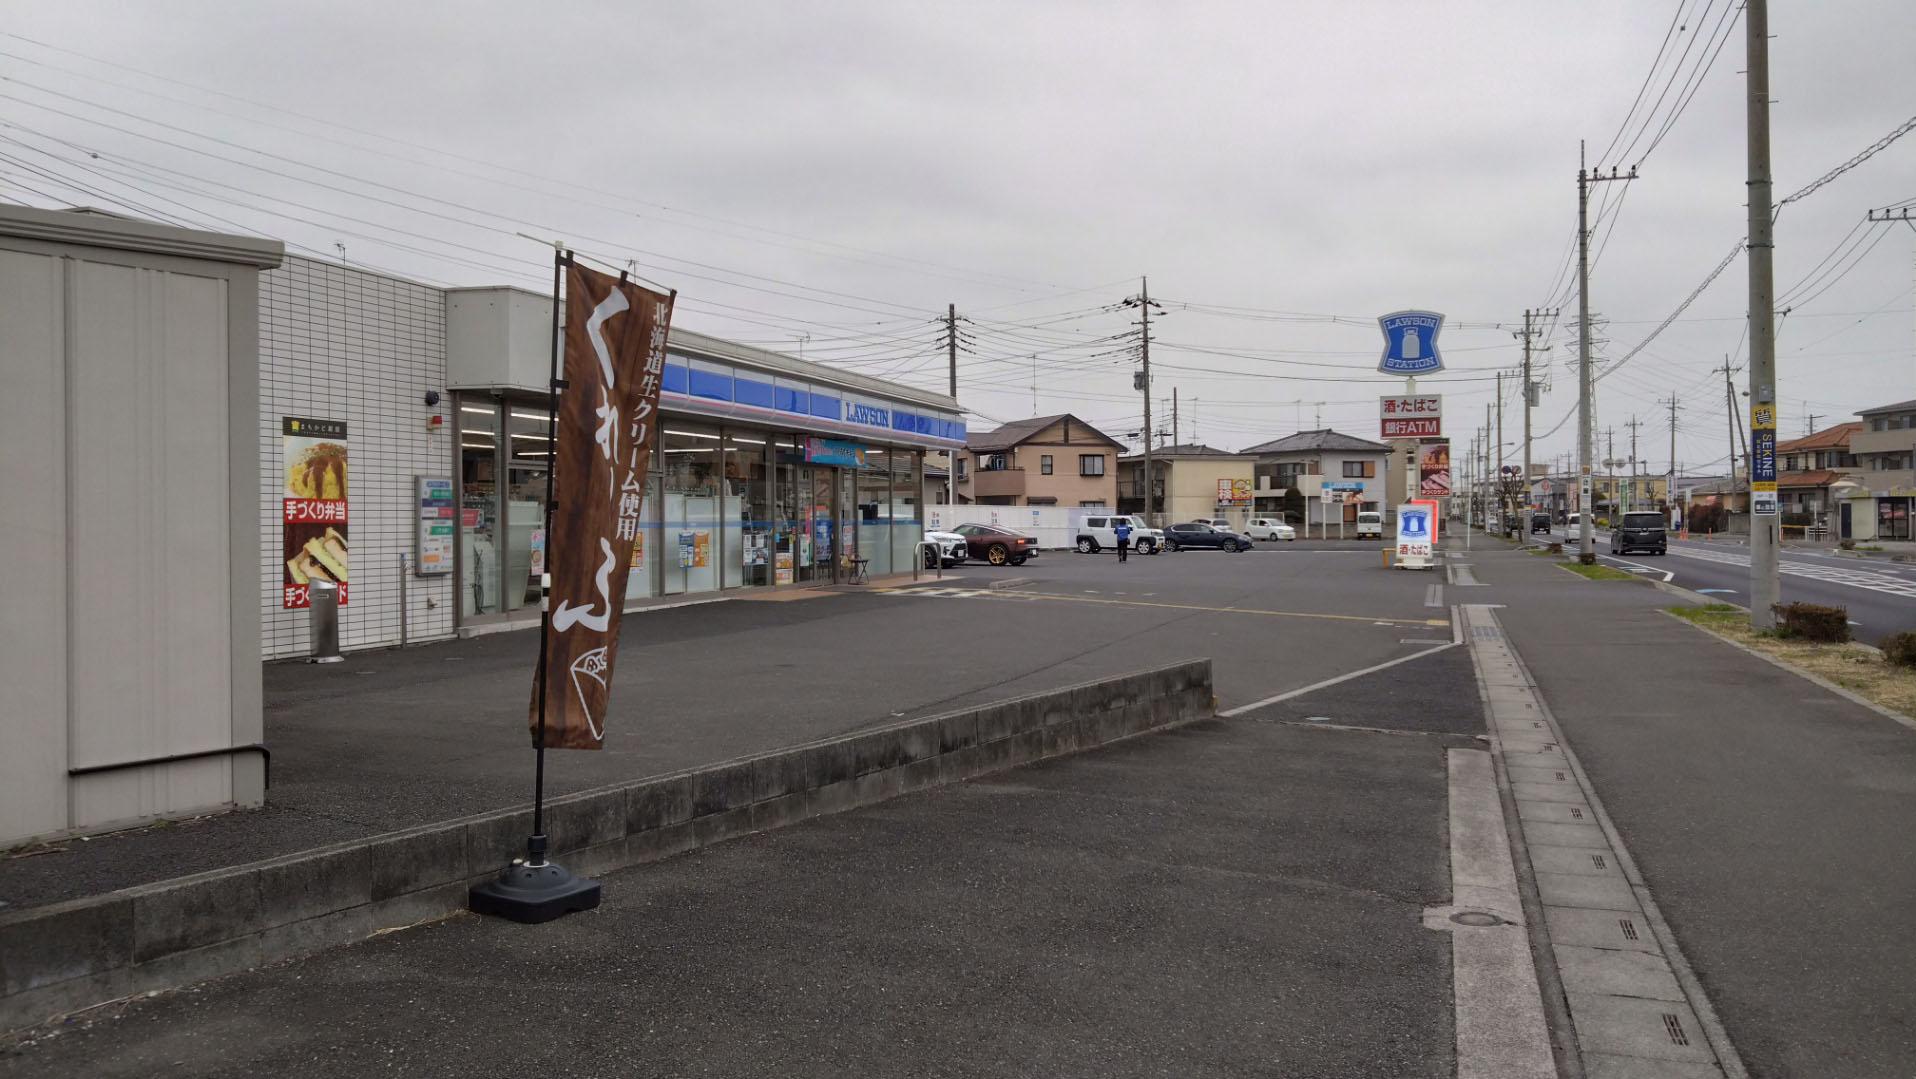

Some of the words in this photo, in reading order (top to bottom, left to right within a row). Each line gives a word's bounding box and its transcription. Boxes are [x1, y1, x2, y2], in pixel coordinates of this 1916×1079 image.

[1386, 317, 1436, 329] LAWSON
[1386, 356, 1436, 369] STATION
[845, 402, 889, 428] LAWSON
[1384, 399, 1438, 413] 酒・たばこ
[616, 302, 668, 541] 北海道生クリーム使用
[1756, 408, 1772, 426] 質
[1385, 420, 1437, 433] 銀行ATM
[1762, 434, 1773, 477] SEKINE
[286, 501, 346, 520] 手づくり弁当
